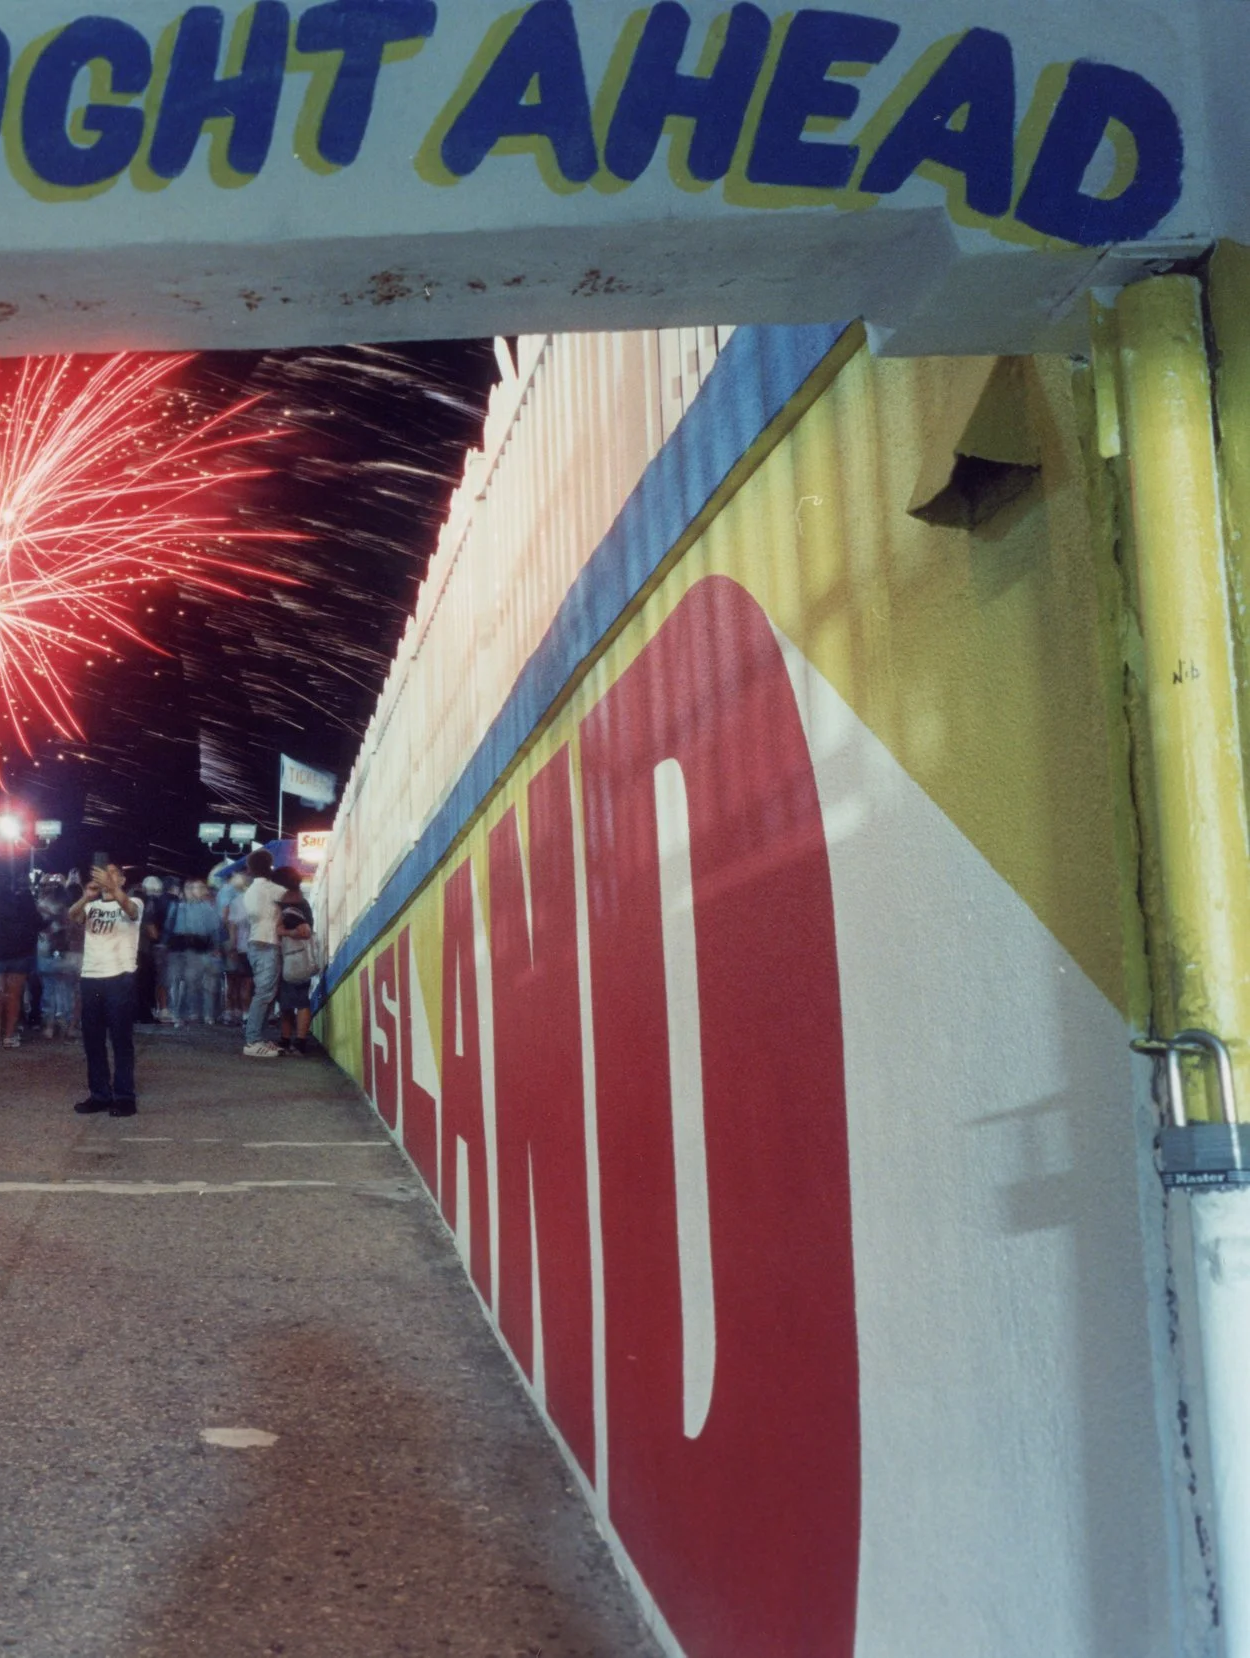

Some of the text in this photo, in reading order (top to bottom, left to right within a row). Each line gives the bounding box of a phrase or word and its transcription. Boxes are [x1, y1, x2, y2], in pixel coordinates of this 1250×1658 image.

[414, 0, 1185, 252] AHEAD
[92, 918, 116, 935] CITY
[359, 574, 863, 1658] ISLAND
[1175, 1173, 1226, 1185] Master
